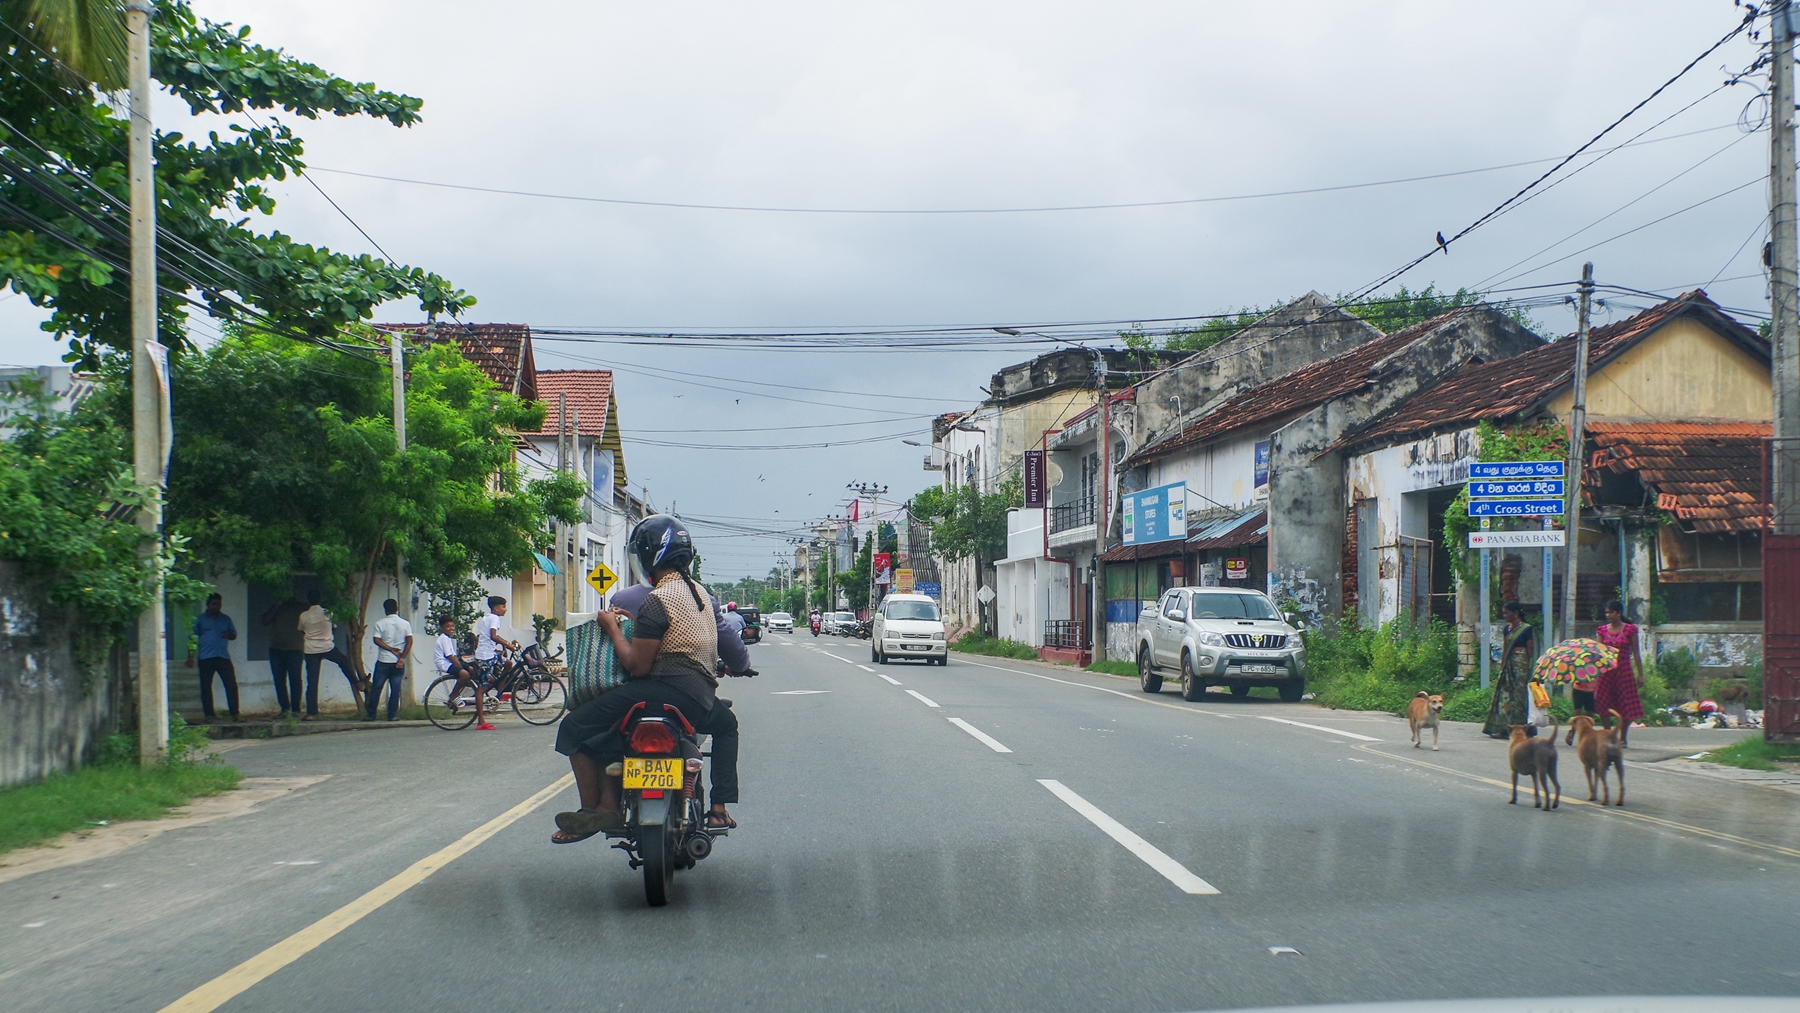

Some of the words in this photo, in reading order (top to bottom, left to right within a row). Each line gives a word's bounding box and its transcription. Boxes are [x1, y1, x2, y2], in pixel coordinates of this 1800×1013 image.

[1030, 457, 1038, 487] Premier
[1475, 466, 1480, 474] 4
[1536, 463, 1558, 474] தெரு
[1477, 484, 1484, 493] 4
[1475, 503, 1490, 514] 4th
[1494, 504, 1522, 514] Cross
[1525, 504, 1557, 513] Street
[1487, 535, 1506, 544] PAN
[1507, 535, 1532, 543] ASIA
[1533, 534, 1561, 543] BANK
[644, 760, 673, 773] BAV
[627, 769, 641, 778] NP
[642, 774, 674, 787] 7700
